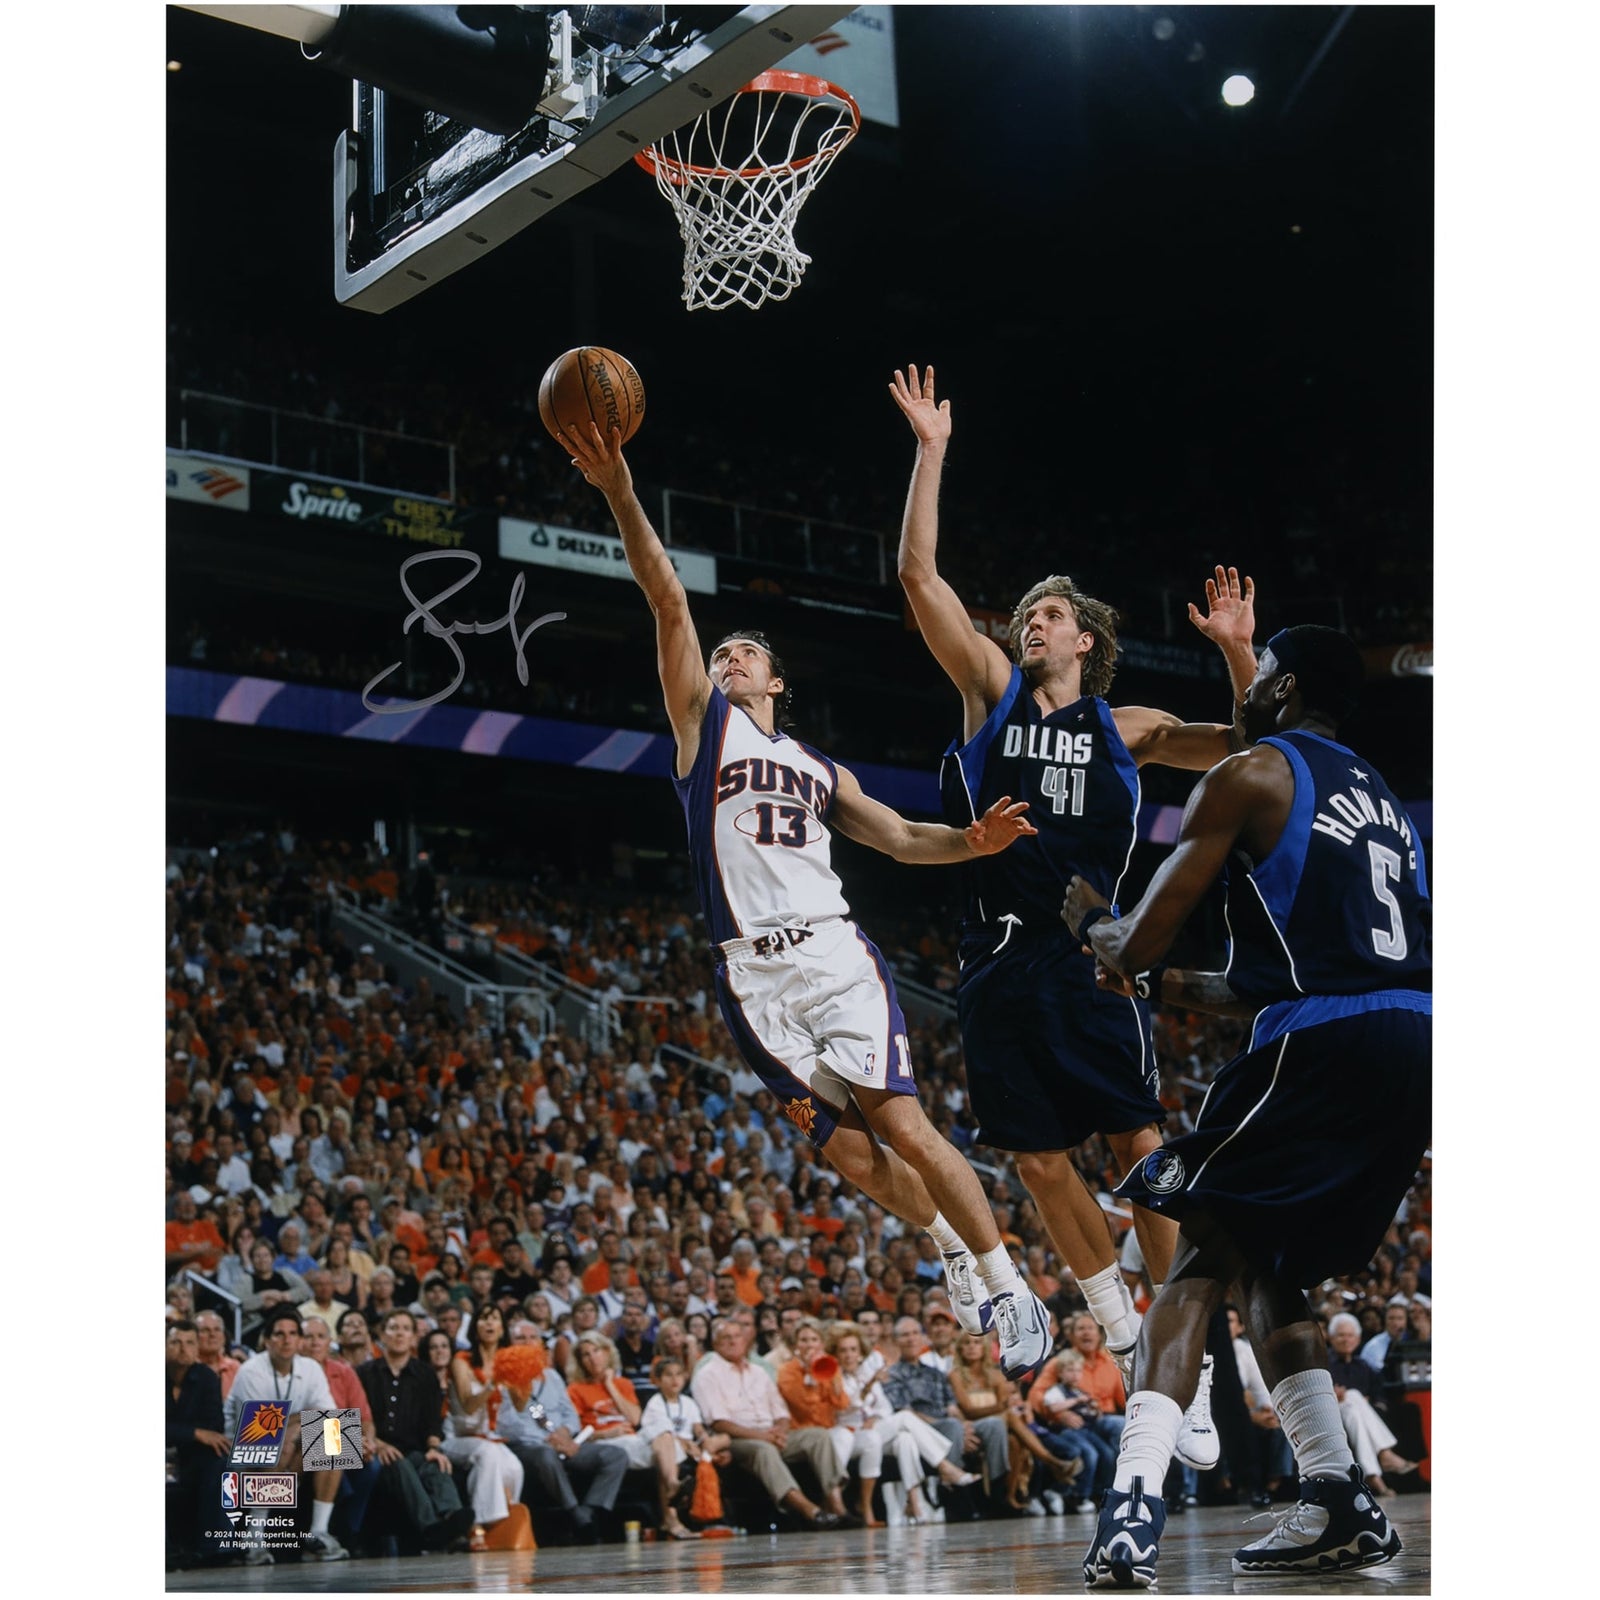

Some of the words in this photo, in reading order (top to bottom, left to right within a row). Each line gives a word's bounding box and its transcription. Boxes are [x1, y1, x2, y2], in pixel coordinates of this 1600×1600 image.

[281, 481, 363, 523] Sprite
[557, 535, 609, 559] DELTA
[718, 758, 830, 820] SUNS
[1040, 766, 1086, 816] 41
[755, 801, 807, 849] 13
[1367, 839, 1408, 962] 5
[1135, 970, 1150, 999] 5
